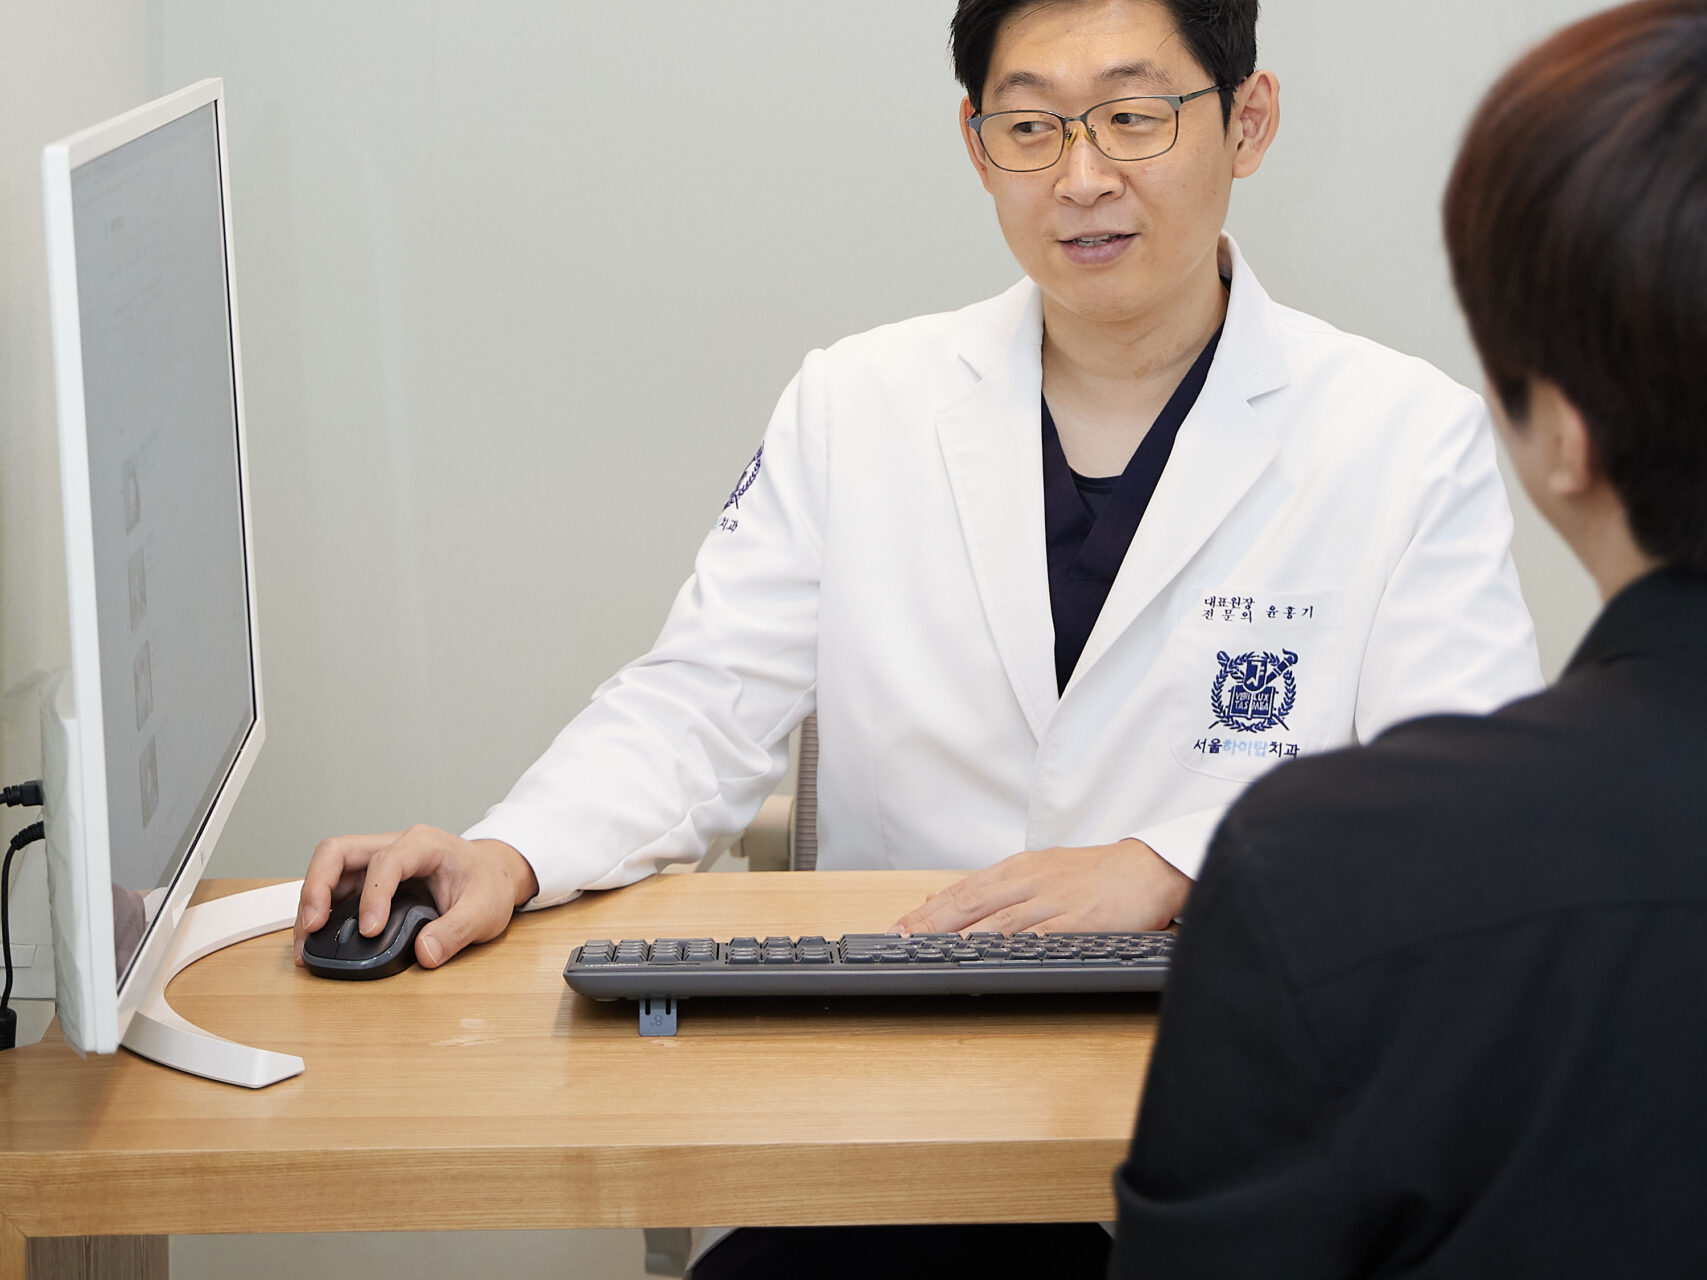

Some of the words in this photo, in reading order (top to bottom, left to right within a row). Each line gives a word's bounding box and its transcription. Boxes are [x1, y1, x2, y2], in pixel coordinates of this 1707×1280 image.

[1204, 595, 1256, 610] 대표원장
[1253, 692, 1269, 702] LUX
[1235, 700, 1249, 710] TAS
